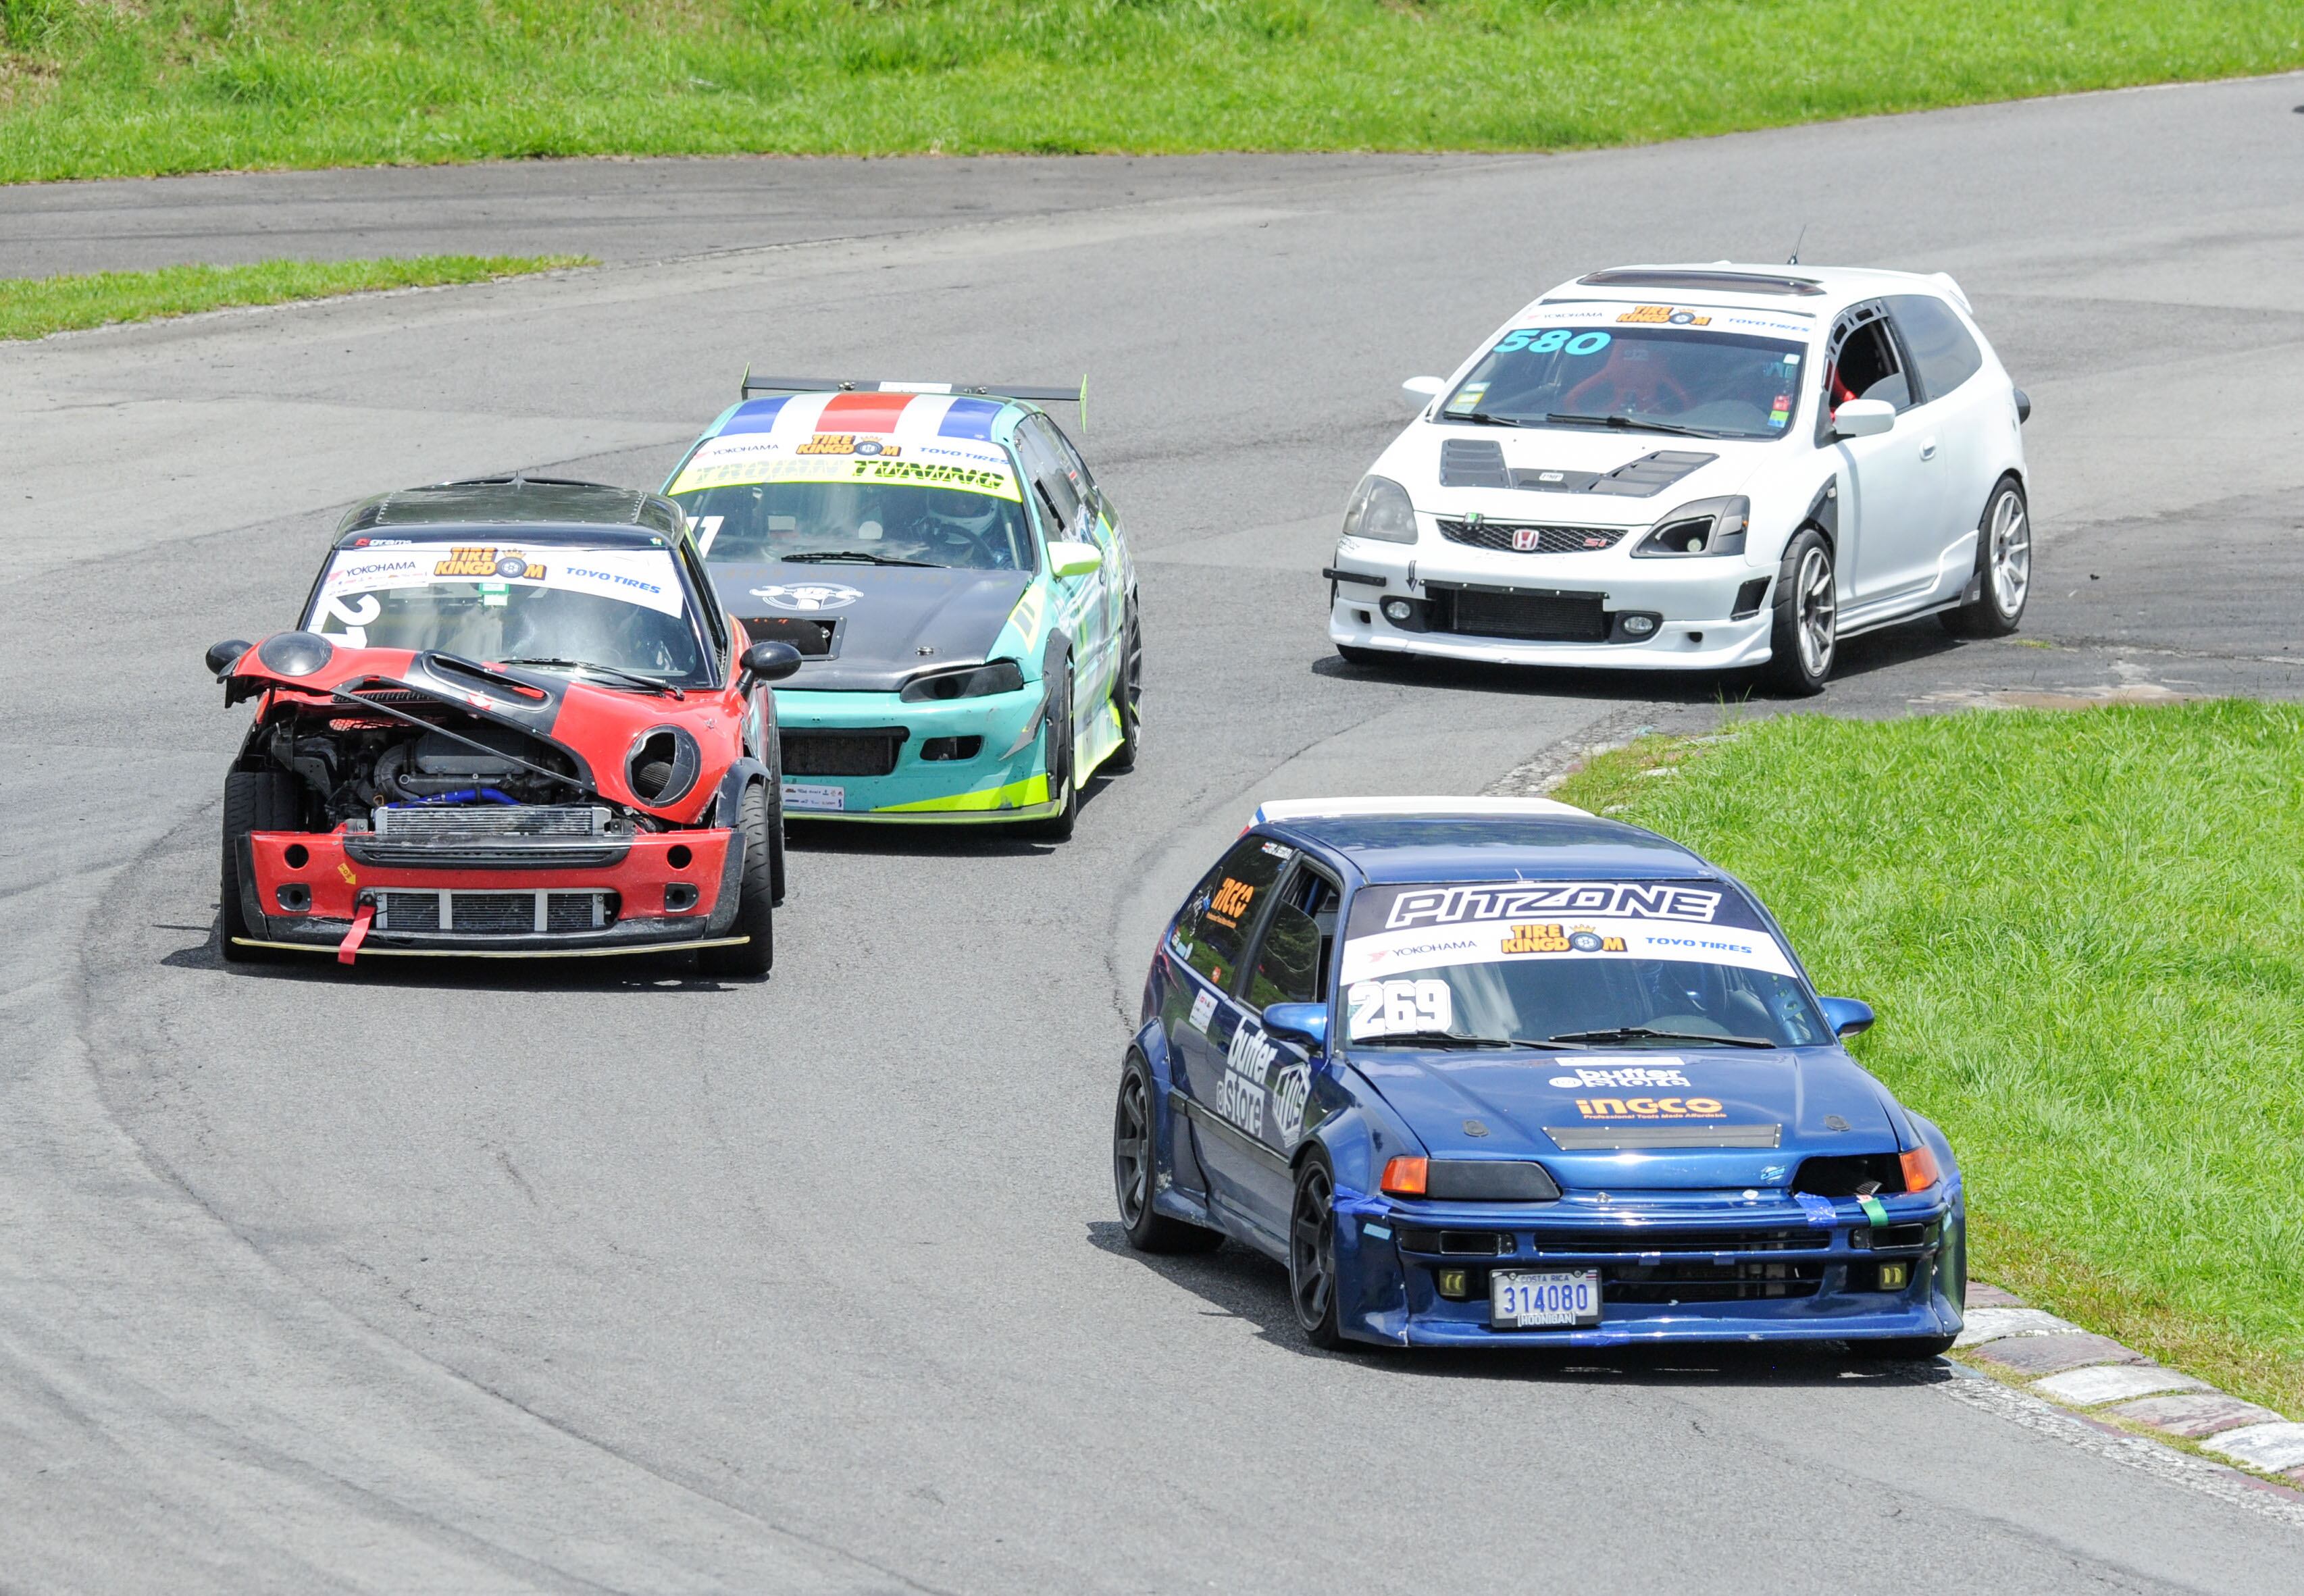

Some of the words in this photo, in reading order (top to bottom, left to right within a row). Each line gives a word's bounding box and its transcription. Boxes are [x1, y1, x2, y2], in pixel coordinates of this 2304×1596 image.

[1635, 306, 1674, 314] TIRE
[1729, 317, 1766, 326] TOYO
[1770, 322, 1811, 332] TIRES
[1493, 330, 1612, 355] 580
[812, 434, 856, 444] TIRE
[713, 444, 779, 455] YOKOHAMA
[921, 447, 961, 456] TOYO
[966, 453, 1010, 465] TIRES
[852, 460, 1004, 489] TUNING
[369, 538, 412, 546] grams
[451, 547, 498, 562] TIRE
[347, 561, 415, 577] YOKOHAMA
[567, 567, 610, 580] TOYO
[614, 575, 661, 594] TIRES
[1385, 883, 1722, 929] PITZONE
[1510, 924, 1565, 939] TIRE
[1393, 941, 1477, 956] YOKOHAMA
[1645, 937, 1696, 947] TOYO
[1699, 941, 1752, 954] TIRES
[1348, 979, 1452, 1040] 269
[1227, 1016, 1278, 1085] buffer
[1575, 1069, 1681, 1079] buffer
[1224, 1070, 1265, 1138] store
[1521, 1275, 1547, 1283] COSTA
[1551, 1274, 1570, 1282] RICA
[1504, 1284, 1588, 1313] 314080
